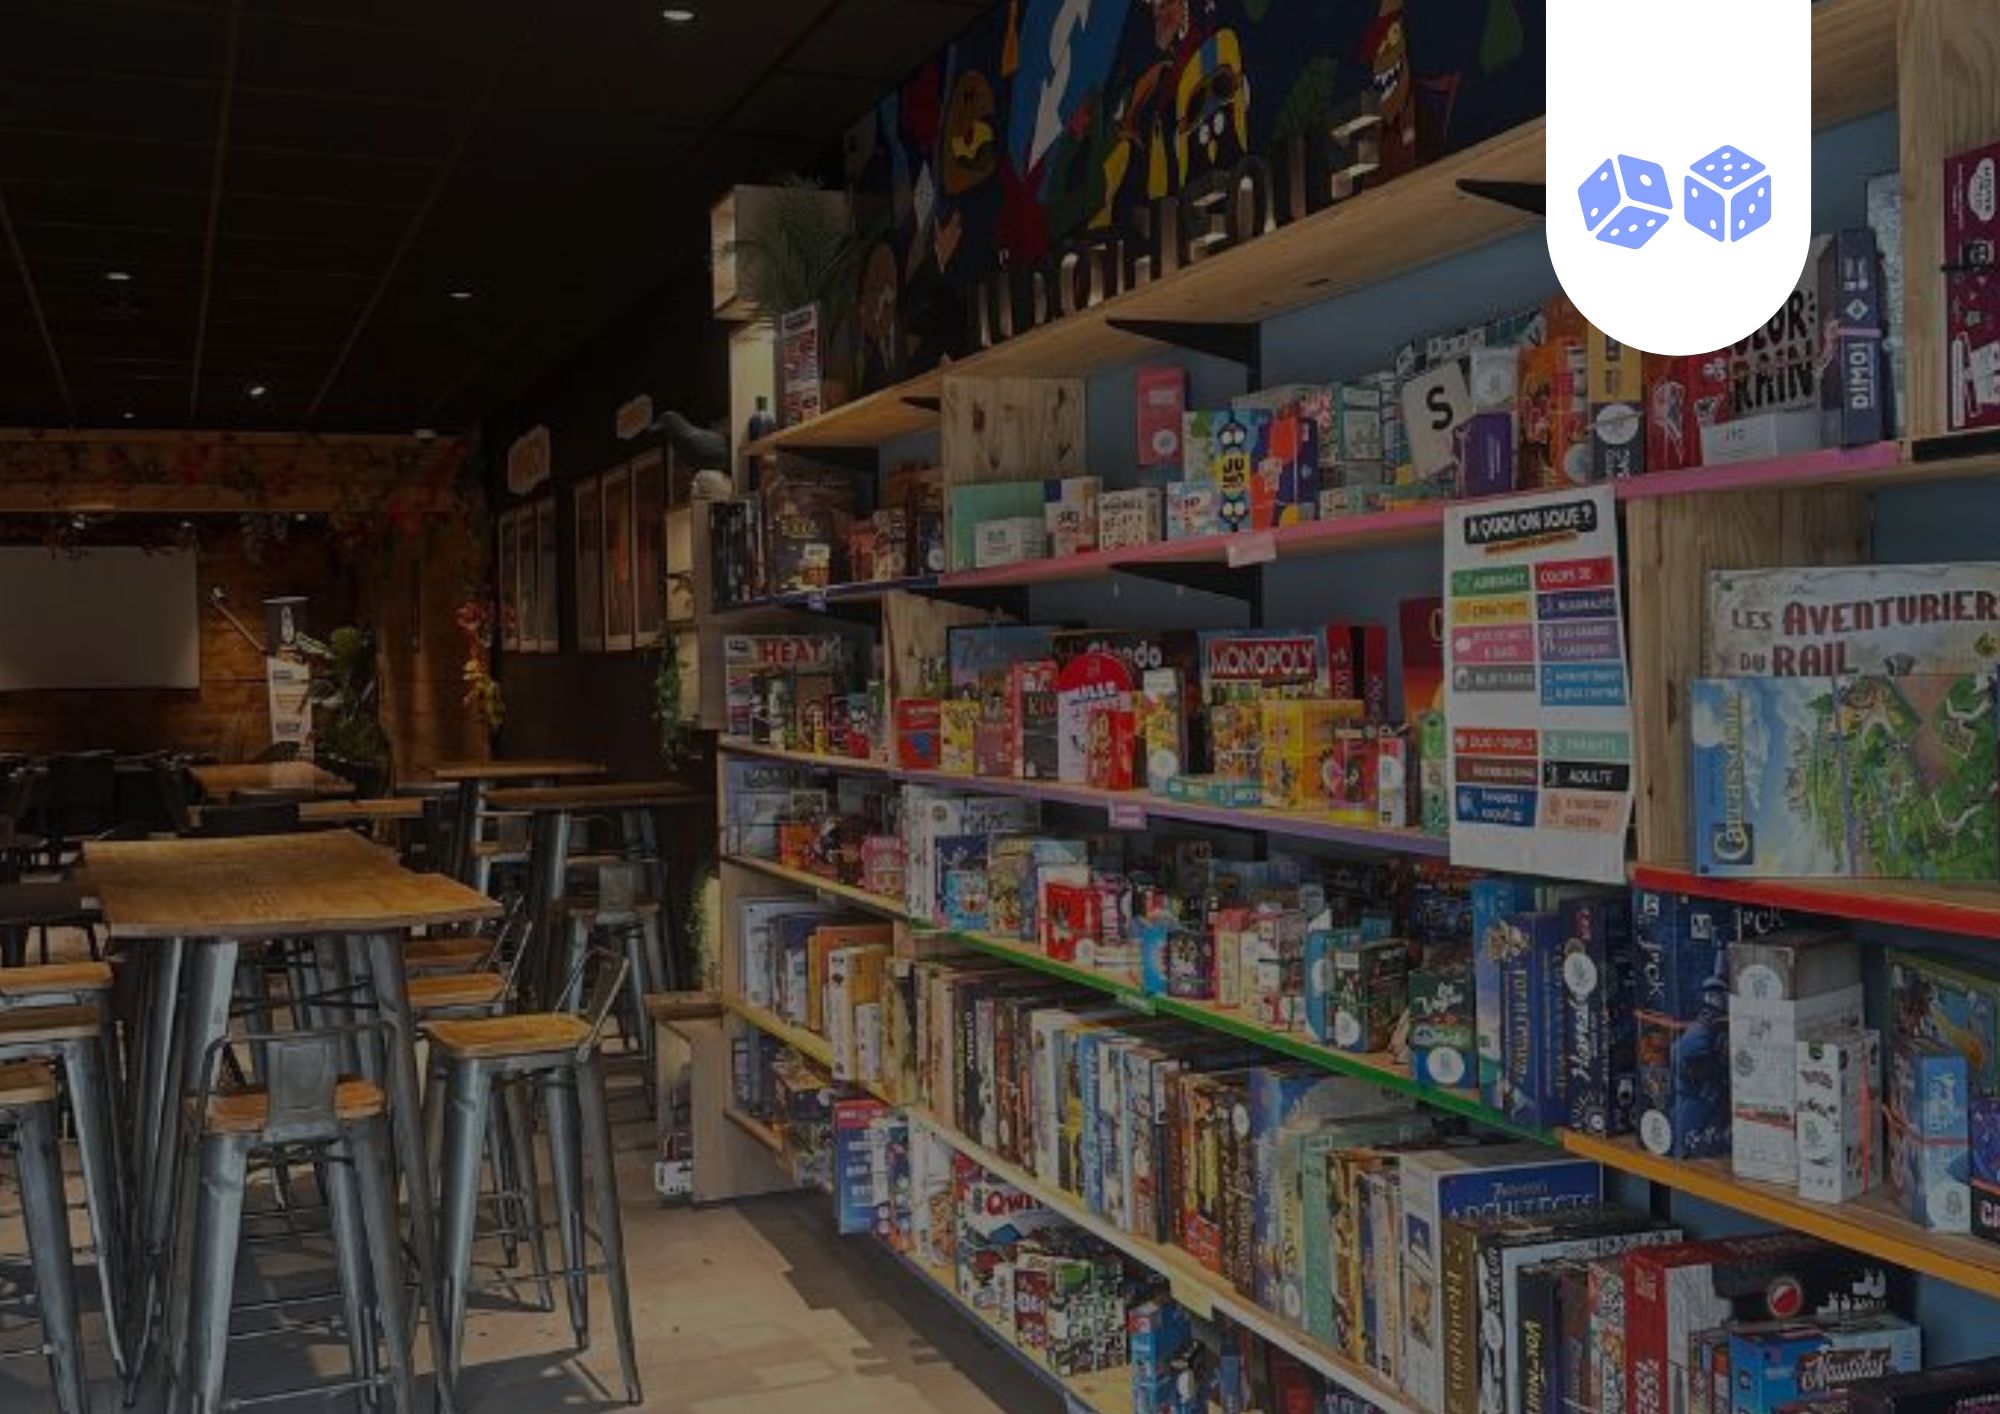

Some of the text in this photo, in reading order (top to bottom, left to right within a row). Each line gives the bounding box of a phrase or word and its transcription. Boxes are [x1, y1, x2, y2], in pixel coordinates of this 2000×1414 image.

[1426, 386, 1453, 430] S
[1731, 608, 1772, 630] LES
[761, 639, 823, 663] HEAT
[1210, 642, 1314, 674] MONOPOLY
[1740, 641, 1859, 676] DU RAIL
[1569, 769, 1614, 785] ADULTE
